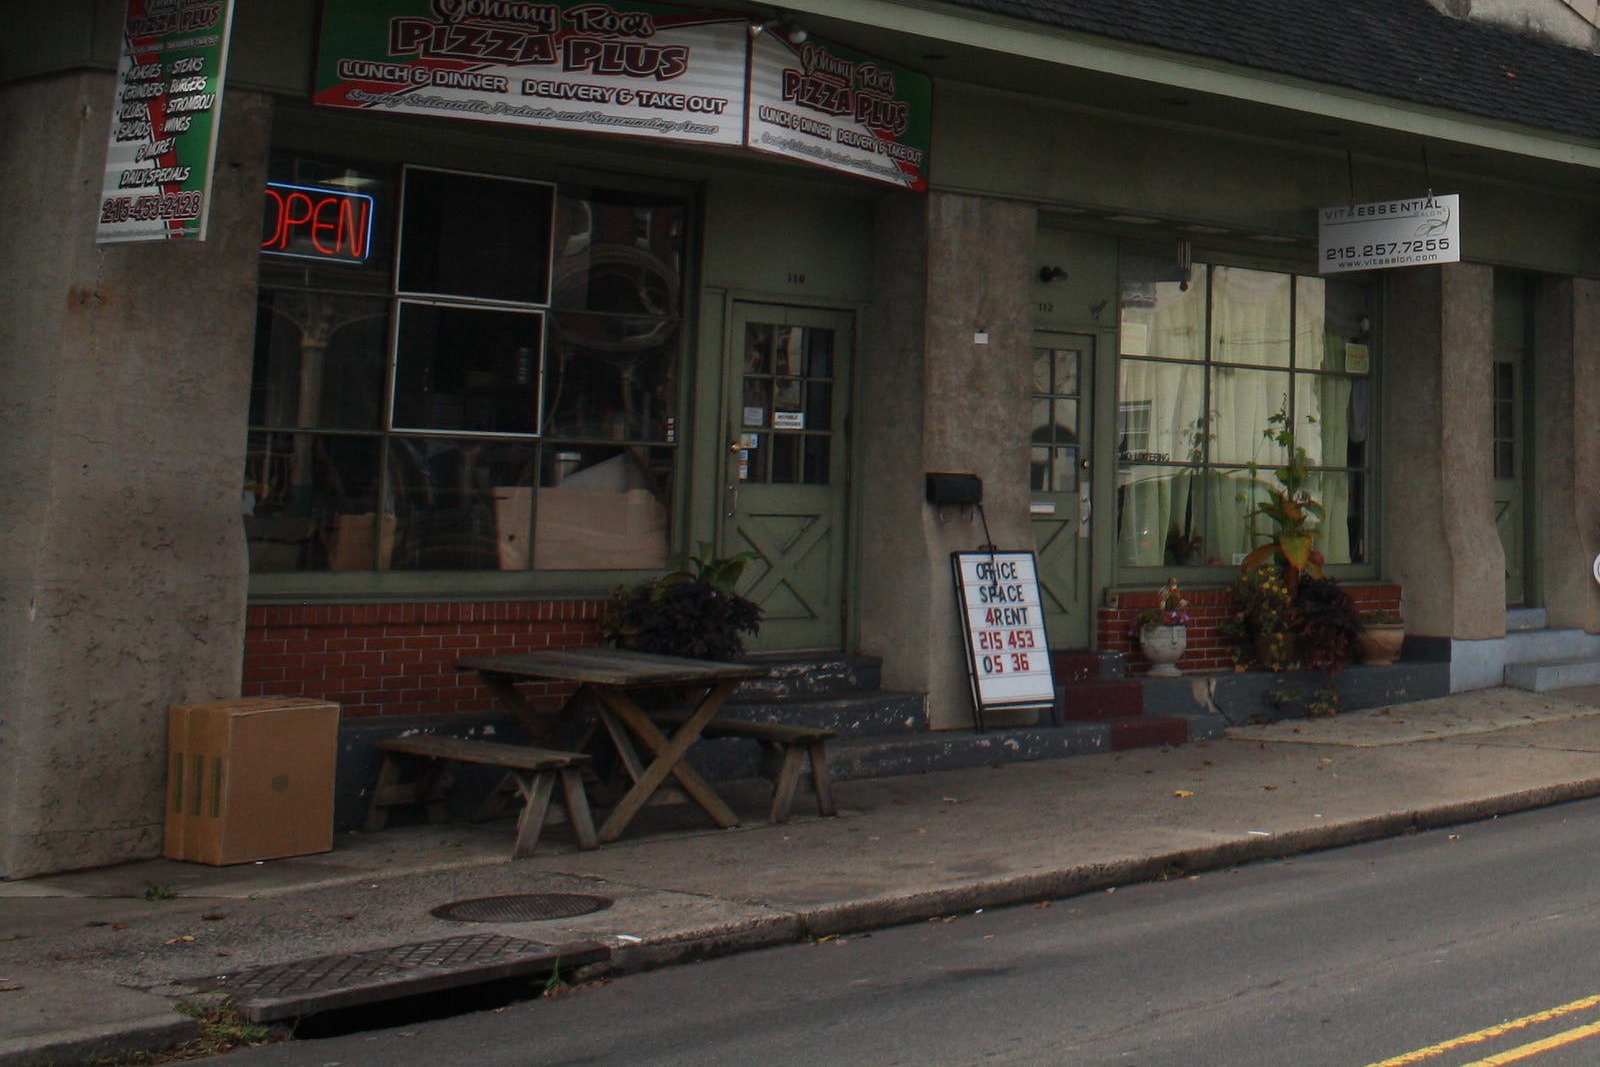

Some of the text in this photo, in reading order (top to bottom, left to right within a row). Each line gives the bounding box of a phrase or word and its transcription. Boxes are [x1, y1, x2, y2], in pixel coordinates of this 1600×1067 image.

[128, 3, 222, 38] PIZZA PLUS
[563, 4, 655, 36] Roc's
[389, 18, 688, 80] PIZZA PLUS
[127, 64, 162, 81] HOAGIES
[172, 57, 204, 74] STEAKS
[801, 41, 853, 86] Johnny
[124, 82, 164, 100] GRINDERS
[170, 76, 208, 93] BURGERS
[340, 61, 728, 114] LUNCH & DINNER DELIVERY & TAKE OUT
[167, 93, 215, 113] STROMBOLI
[783, 69, 908, 133] PIZZA PLUS
[164, 117, 191, 132] WINGS
[760, 107, 790, 126] LUNCH
[801, 119, 831, 138] DINNER
[837, 129, 877, 151] DELIVERY
[887, 142, 907, 160] TAKE
[907, 149, 922, 164] OUT
[121, 167, 190, 186] DAILY SPECIALS
[101, 192, 201, 222] 215-453-2128
[1327, 238, 1449, 260] 215.257.7255
[1338, 254, 1437, 268] www.vitasalon.com
[979, 585, 1024, 603] SPACE
[979, 630, 1035, 650] 215 453
[1011, 653, 1029, 671] 36
